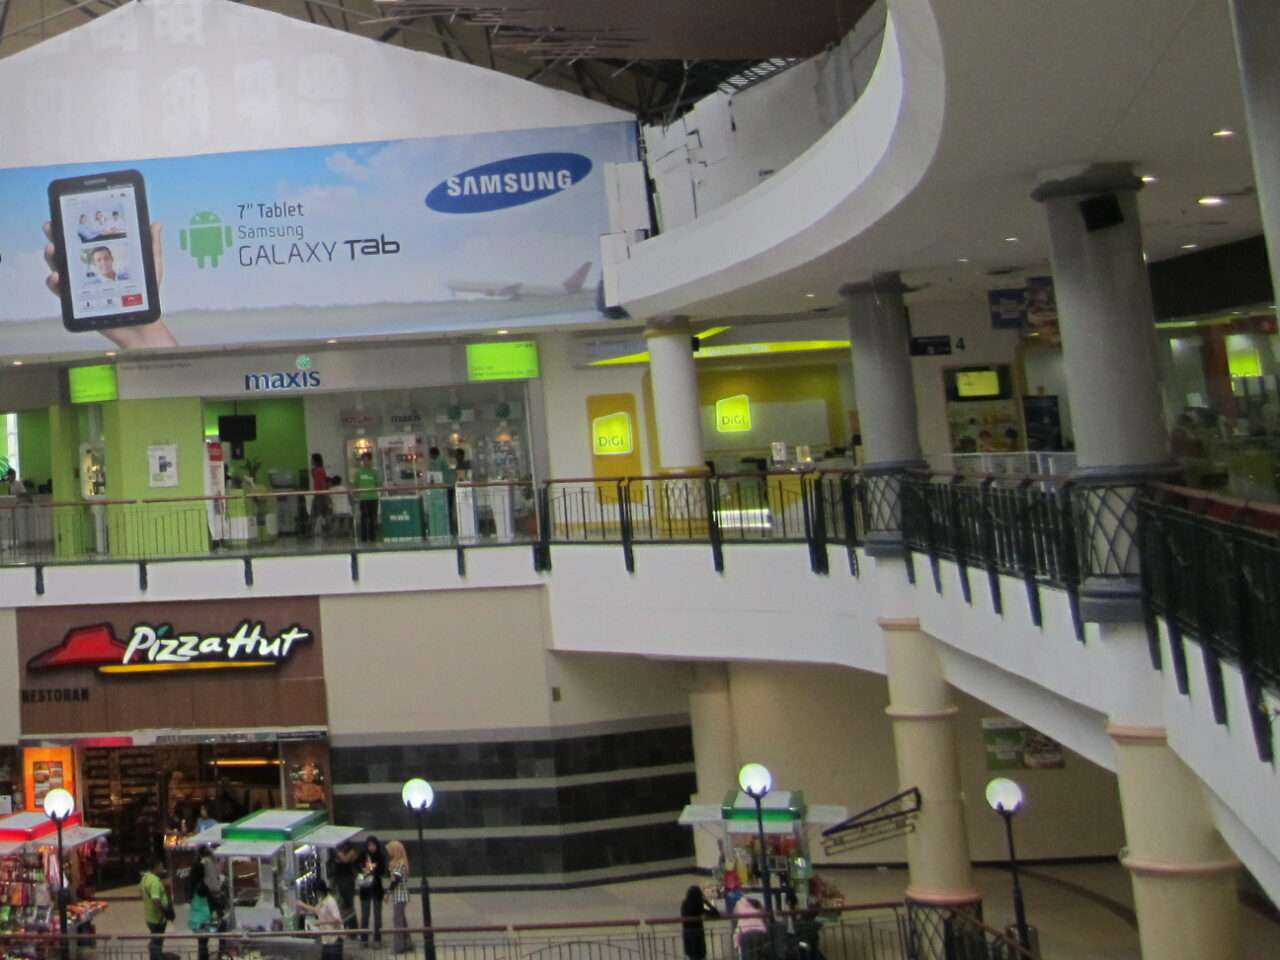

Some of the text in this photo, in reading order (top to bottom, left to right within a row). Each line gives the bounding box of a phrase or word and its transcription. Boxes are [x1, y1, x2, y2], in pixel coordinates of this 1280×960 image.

[447, 170, 572, 197] SAMSUNG
[237, 201, 305, 220] 7" Tablet
[238, 225, 305, 241] Samsung
[239, 233, 401, 267] GALAXY Tab
[956, 337, 966, 351] 4
[245, 370, 321, 391] maxis
[122, 622, 309, 665] Pizza Hut
